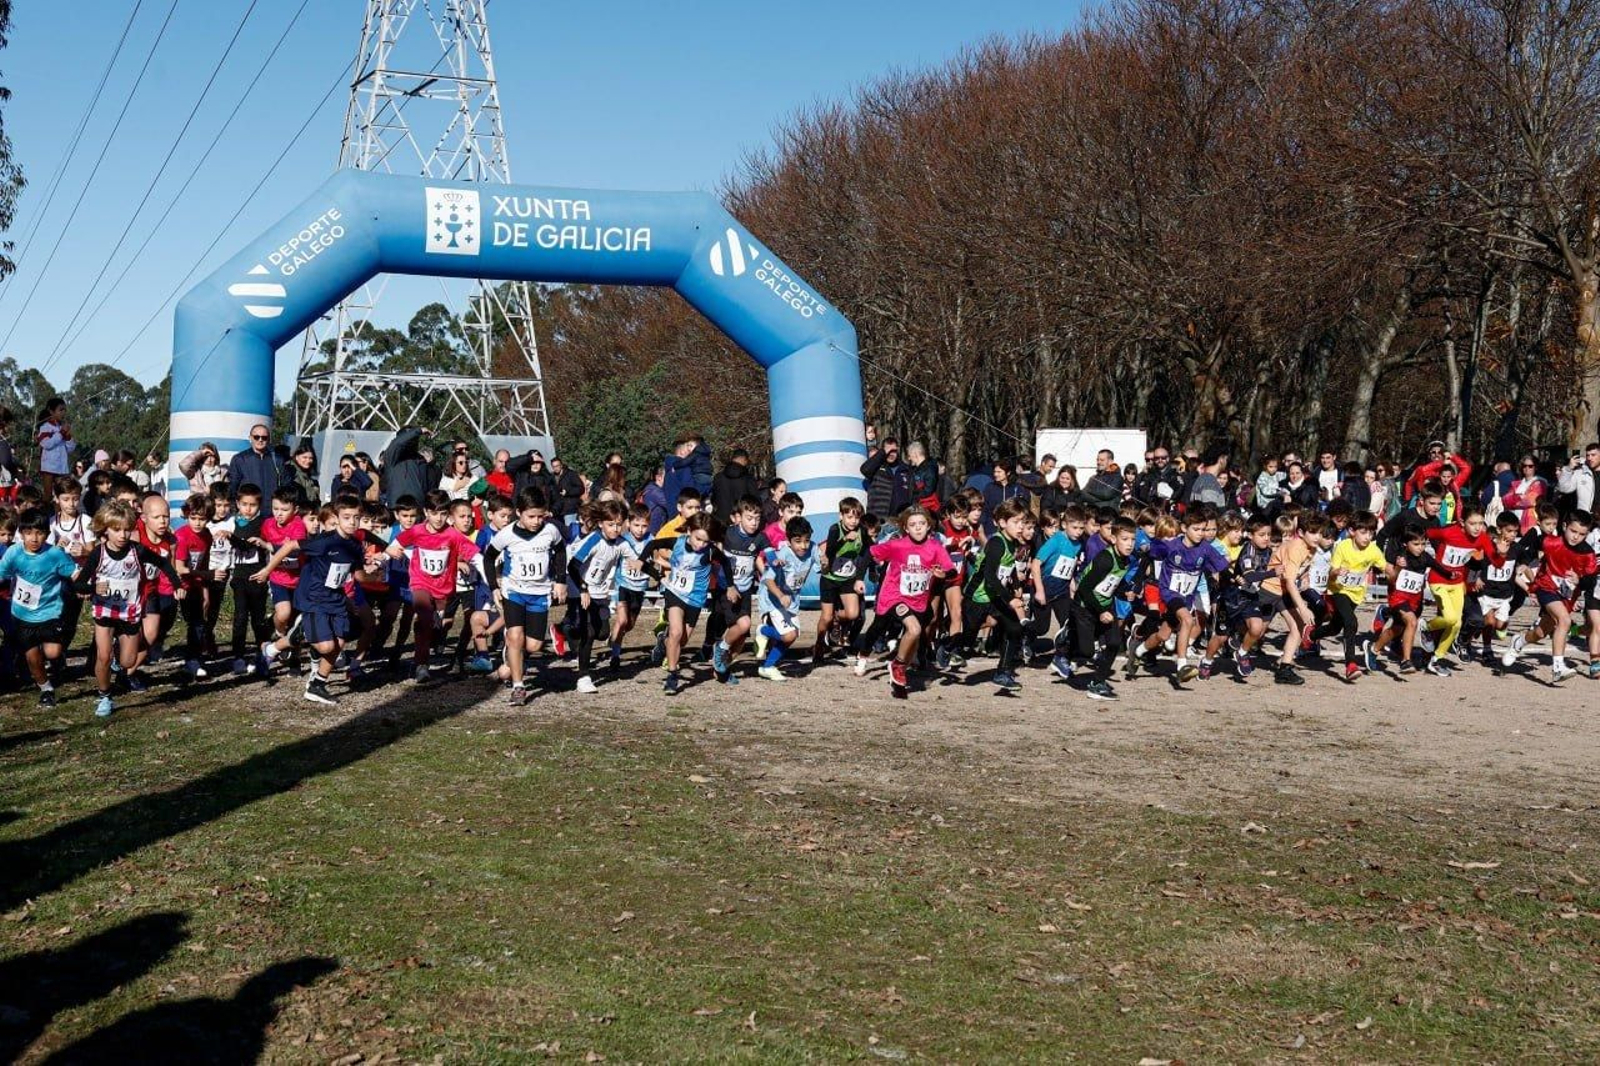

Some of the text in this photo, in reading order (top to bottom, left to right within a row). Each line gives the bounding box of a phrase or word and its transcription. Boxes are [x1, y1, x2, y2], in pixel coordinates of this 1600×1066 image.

[492, 196, 591, 220] XUNTA
[268, 208, 342, 266] DEPORTE
[492, 222, 651, 251] DE GALICIA
[281, 226, 345, 277] GALEGO
[755, 269, 813, 318] GALEGO
[762, 259, 827, 315] DEPORTE
[423, 558, 444, 572] 453
[520, 562, 543, 577] 391
[908, 580, 927, 594] 428
